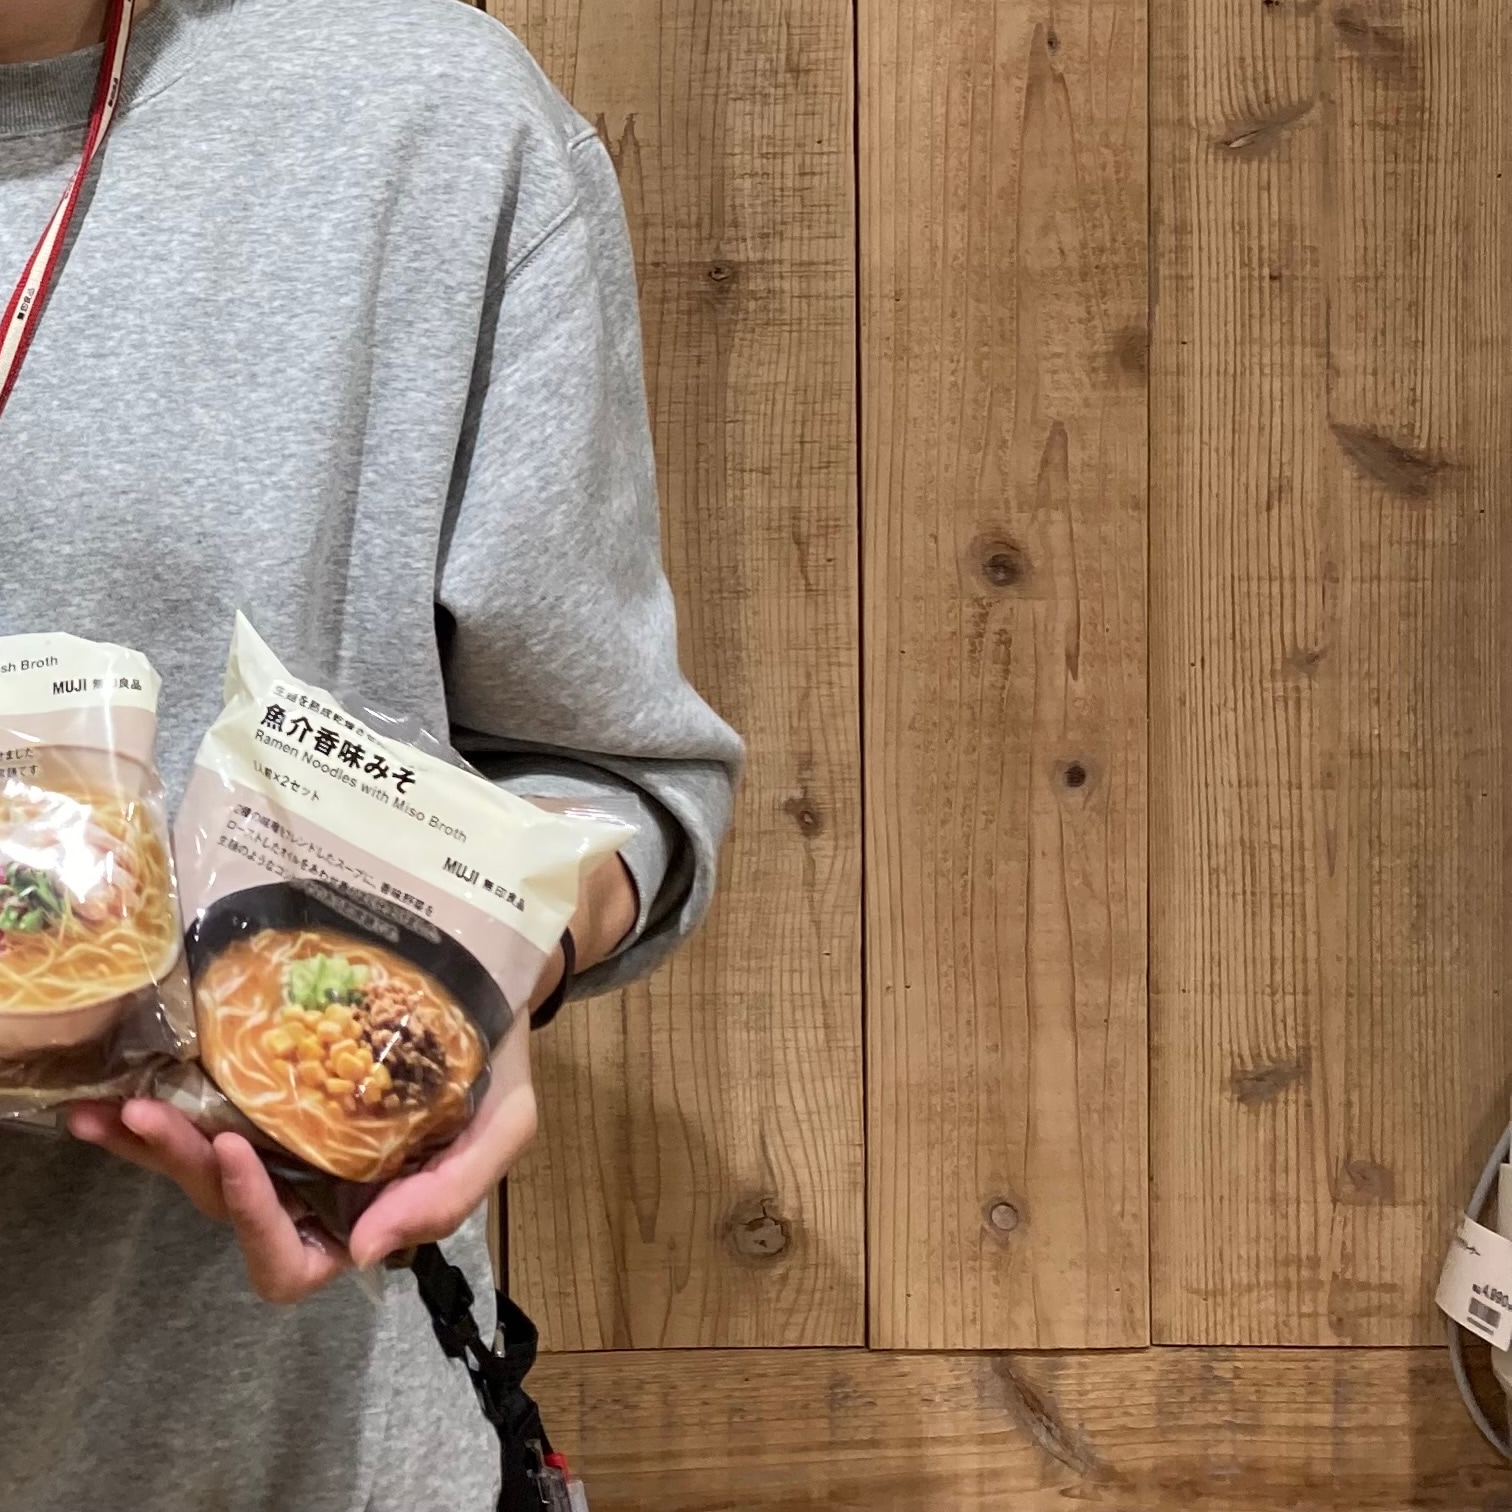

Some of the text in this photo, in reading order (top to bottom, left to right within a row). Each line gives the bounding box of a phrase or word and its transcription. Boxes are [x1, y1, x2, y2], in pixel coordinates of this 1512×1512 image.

[20, 654, 58, 671] Broth
[52, 677, 142, 696] MUJI 無良品
[260, 703, 417, 795] 魚介香味みそ
[254, 729, 468, 844] Ramen Noodles with Miso Broth
[442, 856, 480, 886] MUJI
